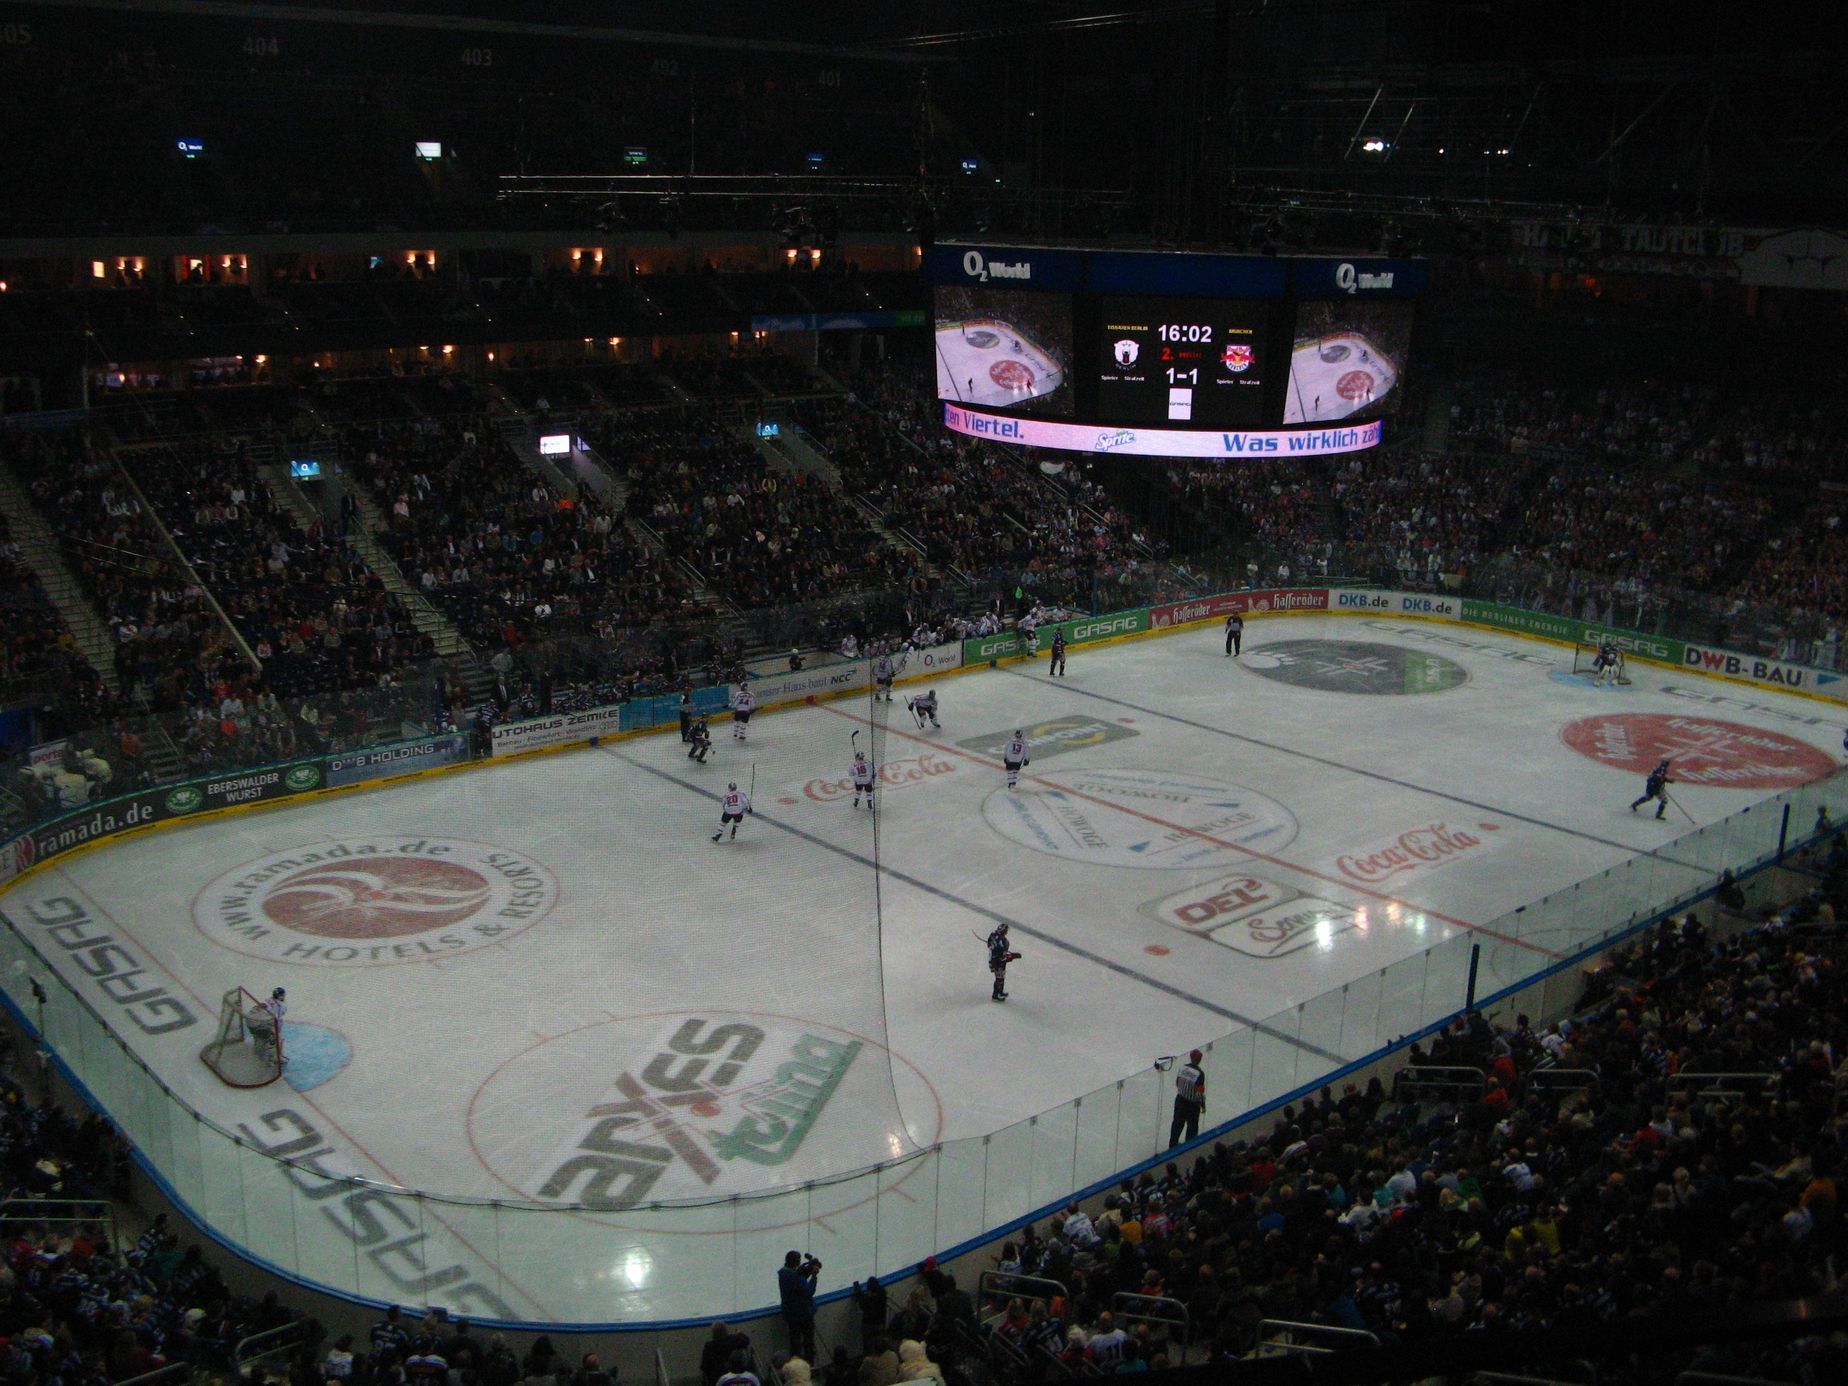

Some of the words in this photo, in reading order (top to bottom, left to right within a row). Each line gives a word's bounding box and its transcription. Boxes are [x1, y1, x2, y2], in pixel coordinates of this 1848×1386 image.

[461, 49, 493, 67] 403
[1158, 324, 1212, 343] 16:02
[1165, 367, 1198, 385] 1-1
[963, 411, 1025, 440] Viertel.
[1095, 430, 1136, 452] Sprite
[1223, 433, 1278, 452] Was
[1288, 428, 1359, 451] wirklich
[1338, 593, 1389, 609] DKB.de
[1402, 597, 1452, 615] DKB.de
[1073, 615, 1138, 641] GASAG
[1584, 629, 1669, 658] GASAG
[783, 681, 807, 693] Haus
[808, 677, 828, 689] baut
[830, 673, 851, 685] NCC
[490, 719, 563, 740] UTOHAUS
[370, 743, 435, 764] HOLDING
[1012, 743, 1022, 755] 13
[207, 773, 280, 796] EBERSWALDER
[226, 787, 263, 803] WURST
[39, 802, 154, 857] ramada.de
[219, 839, 451, 943] www.ramada.de
[282, 931, 463, 962] HOTELS
[478, 852, 546, 921] RESORTS
[1174, 878, 1270, 926] DEL
